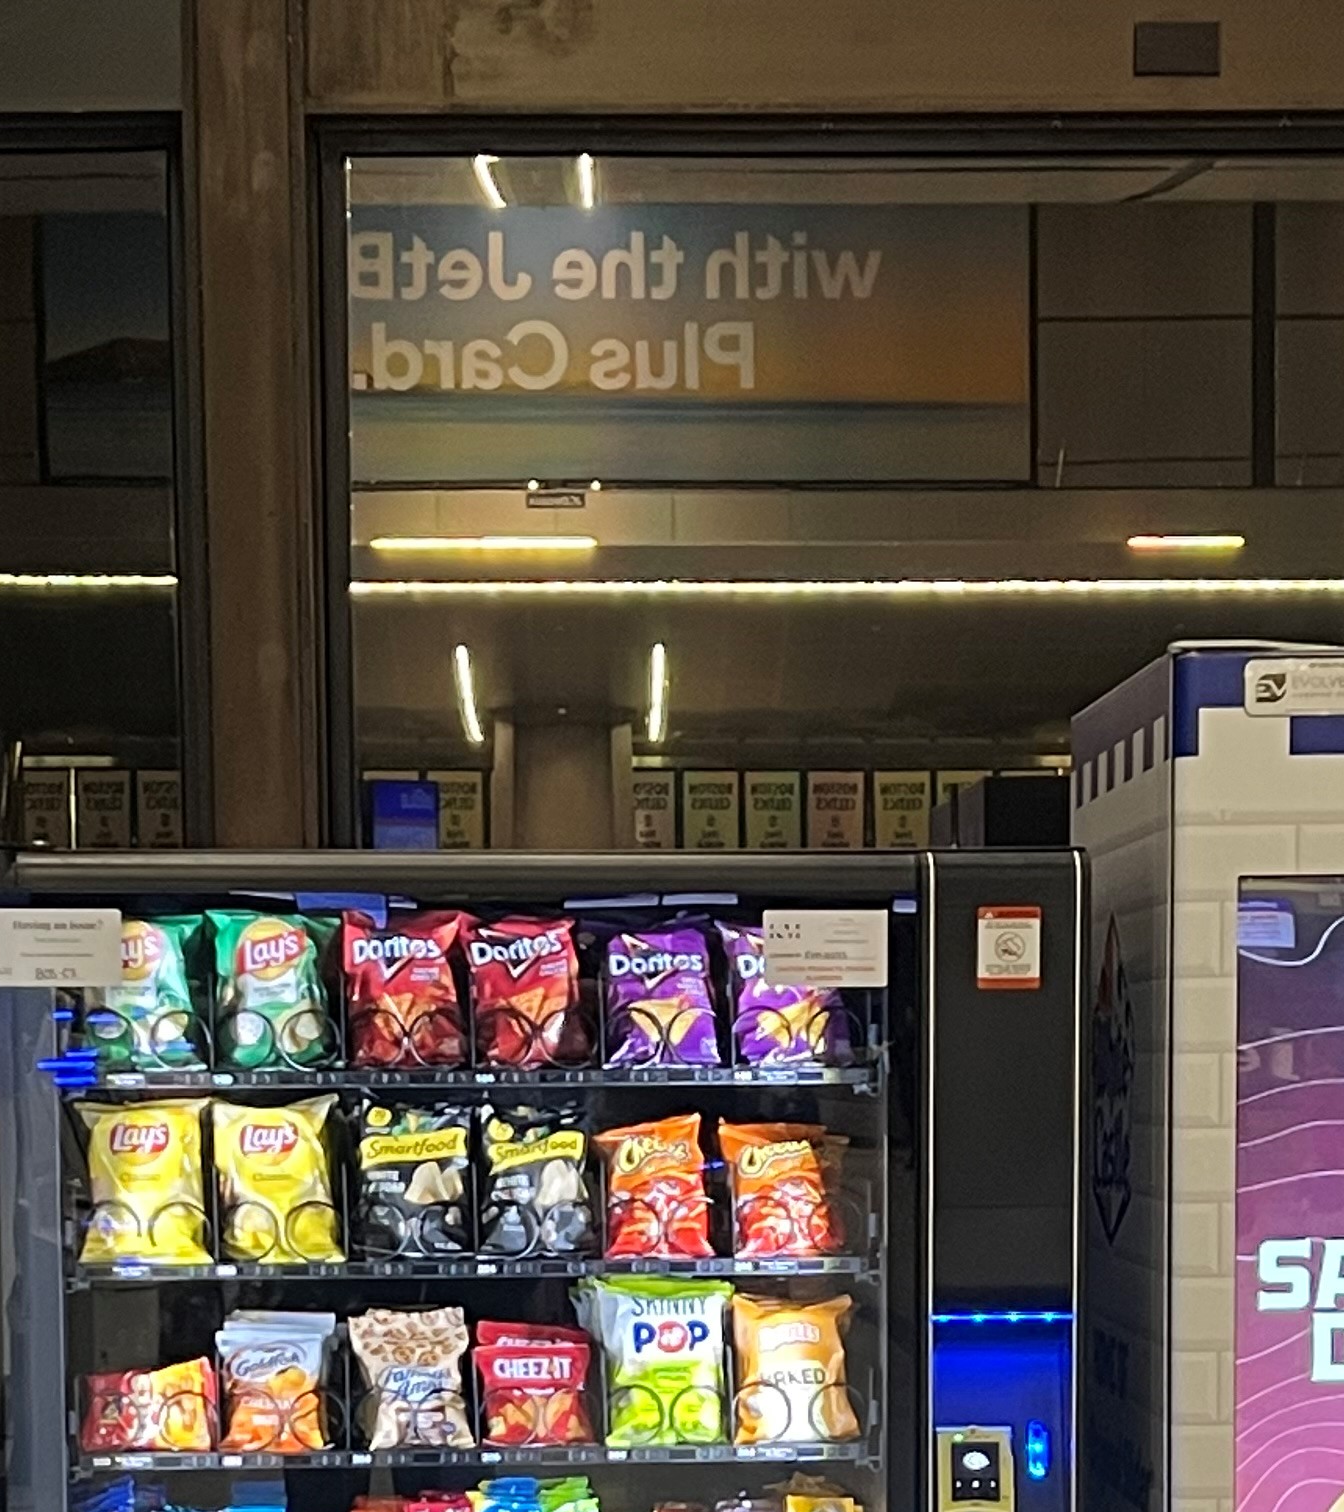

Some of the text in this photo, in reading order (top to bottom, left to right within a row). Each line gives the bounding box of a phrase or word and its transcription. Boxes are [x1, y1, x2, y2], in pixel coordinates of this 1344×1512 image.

[245, 933, 304, 970] Lay's
[353, 936, 442, 964] Doritos
[470, 932, 562, 966] Doritos
[609, 953, 703, 977] Doritos
[367, 1134, 459, 1159] Smartfood
[495, 1138, 579, 1162] Smartfood
[631, 1297, 707, 1317] SKINNY
[633, 1320, 709, 1353] POP
